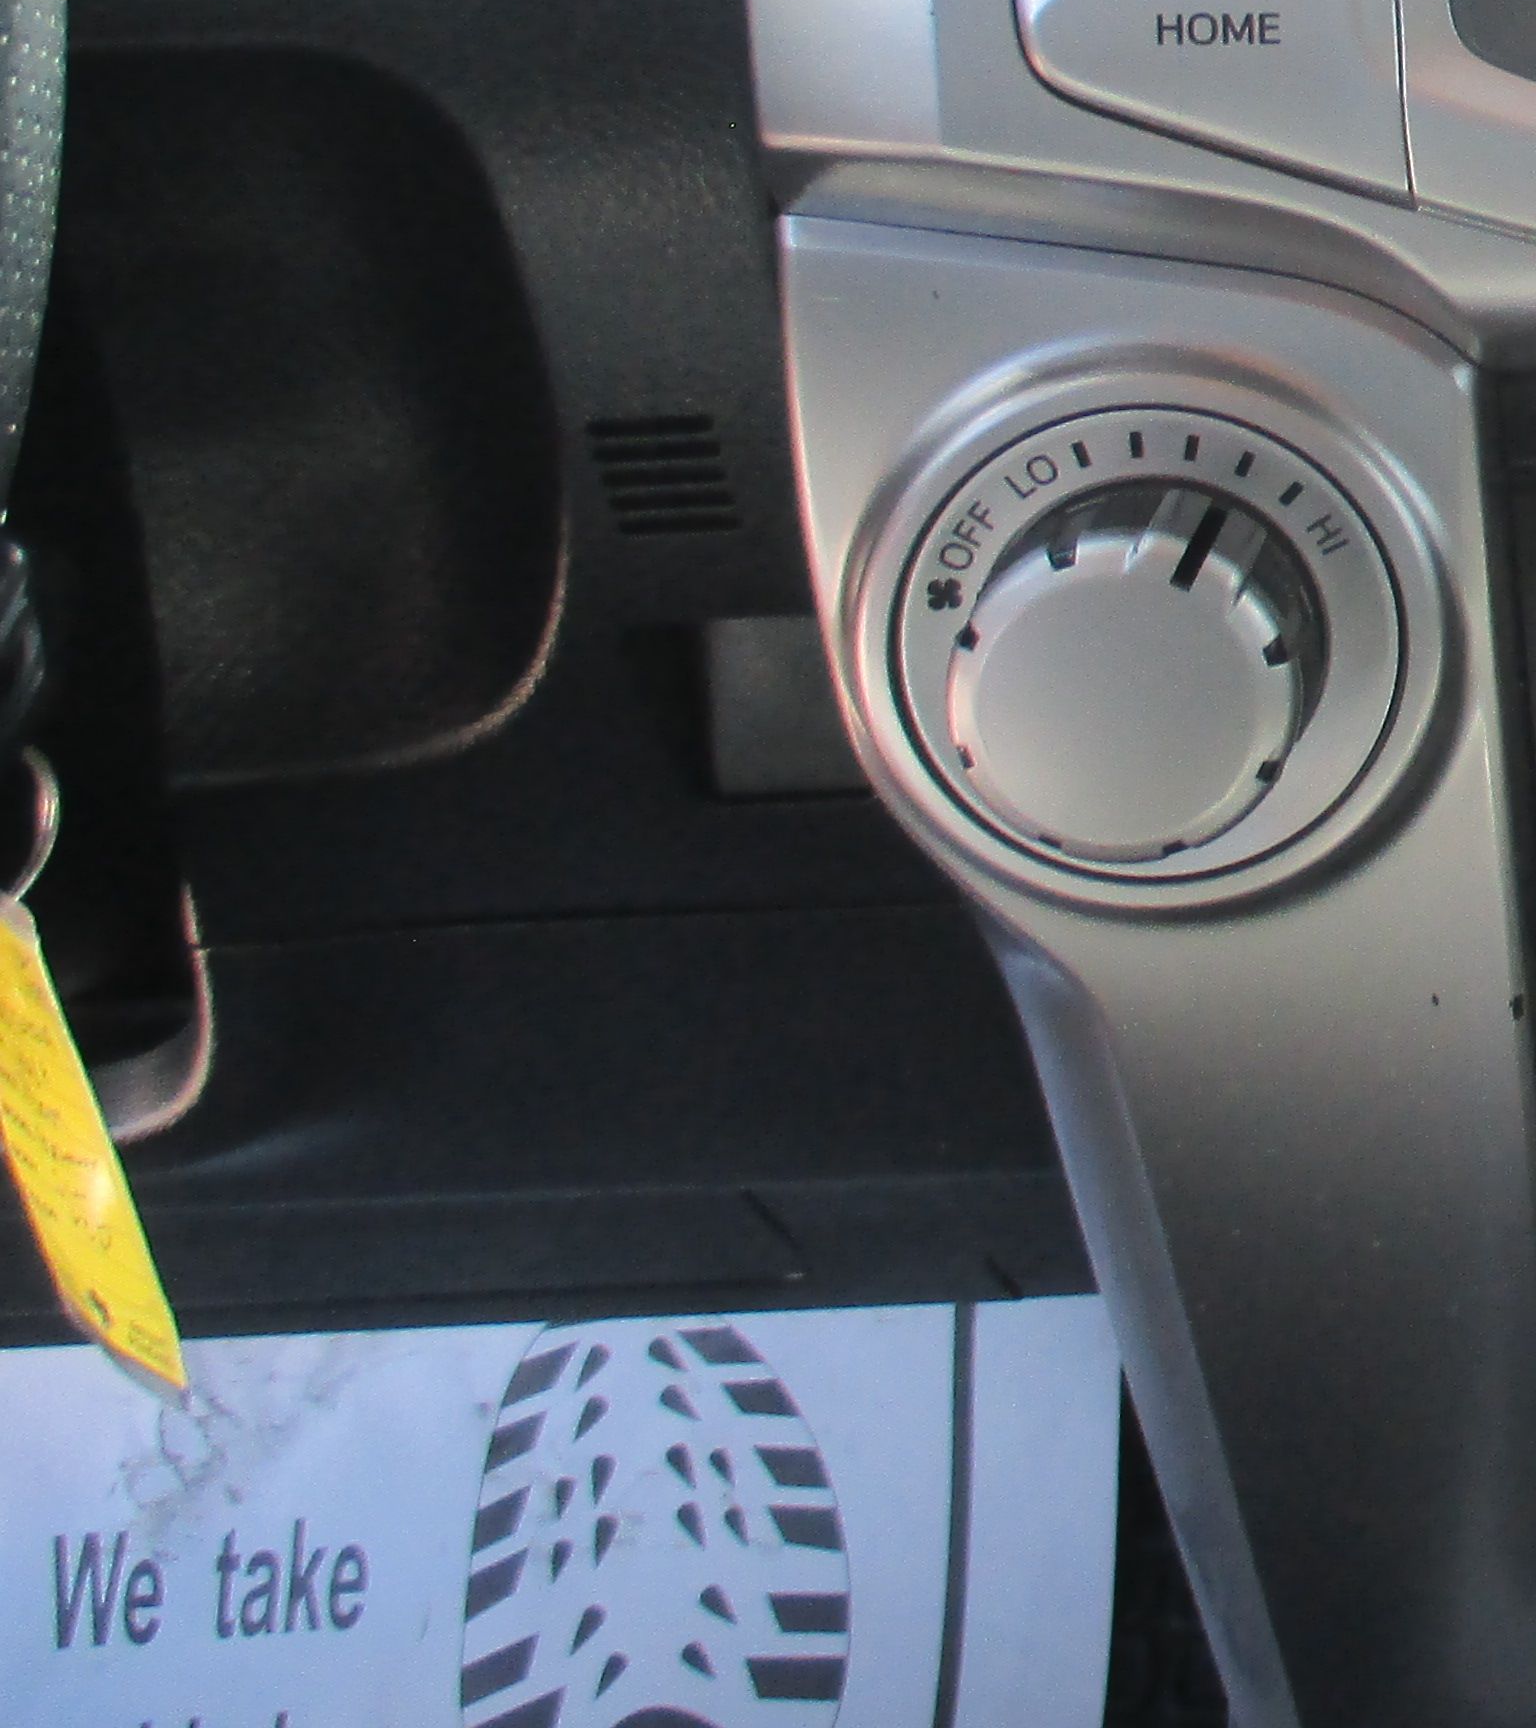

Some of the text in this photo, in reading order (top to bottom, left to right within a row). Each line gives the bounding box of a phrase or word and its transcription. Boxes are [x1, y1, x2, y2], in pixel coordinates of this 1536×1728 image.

[1155, 12, 1283, 48] HOME
[1003, 453, 1060, 501] LO
[939, 498, 996, 573] OFF
[1306, 512, 1350, 557] HI
[53, 1517, 370, 1649] We take
